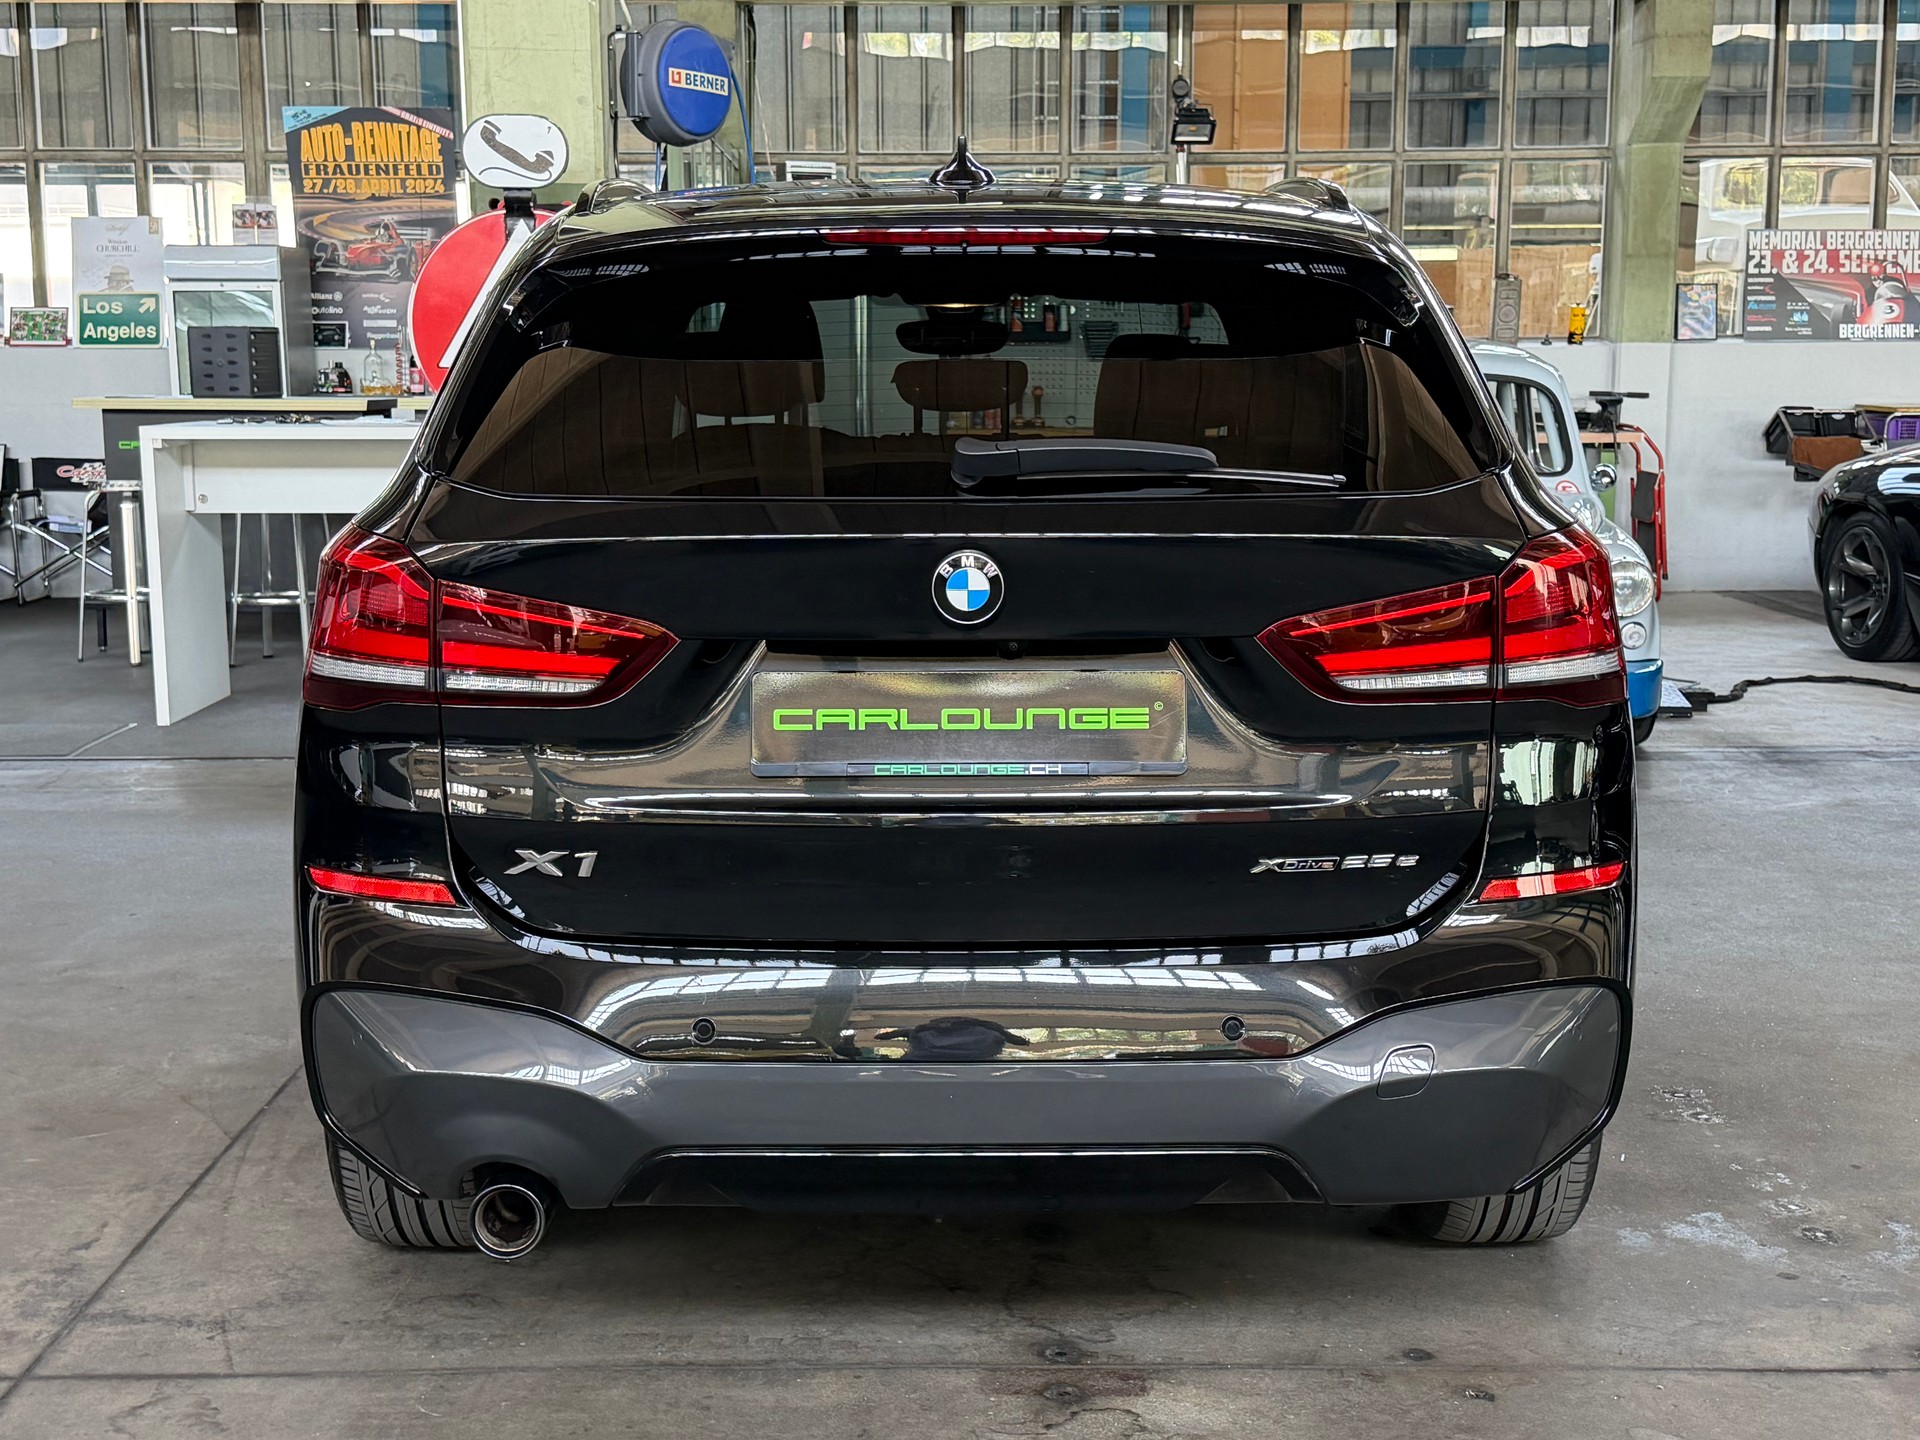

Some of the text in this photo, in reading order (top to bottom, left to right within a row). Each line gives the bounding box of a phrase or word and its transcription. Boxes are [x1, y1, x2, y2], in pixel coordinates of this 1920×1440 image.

[685, 73, 726, 93] BERNER
[300, 121, 443, 163] AUTO-RENNTAGE
[303, 163, 442, 177] FRAUENFELD
[405, 179, 445, 194] 2024
[1749, 230, 1919, 250] MEMORIAL BERGRENNEN
[1747, 250, 1778, 275] 23.
[1782, 250, 1799, 275] &
[1802, 250, 1835, 274] 24.
[83, 298, 123, 314] Los
[83, 321, 157, 342] Angeles
[1839, 323, 1920, 339] BERGRENNEN-
[939, 555, 999, 579] BMW
[772, 707, 1150, 731] CARLOUNGE
[874, 763, 1062, 776] CARLOUNGE.CH
[503, 848, 599, 878] X1
